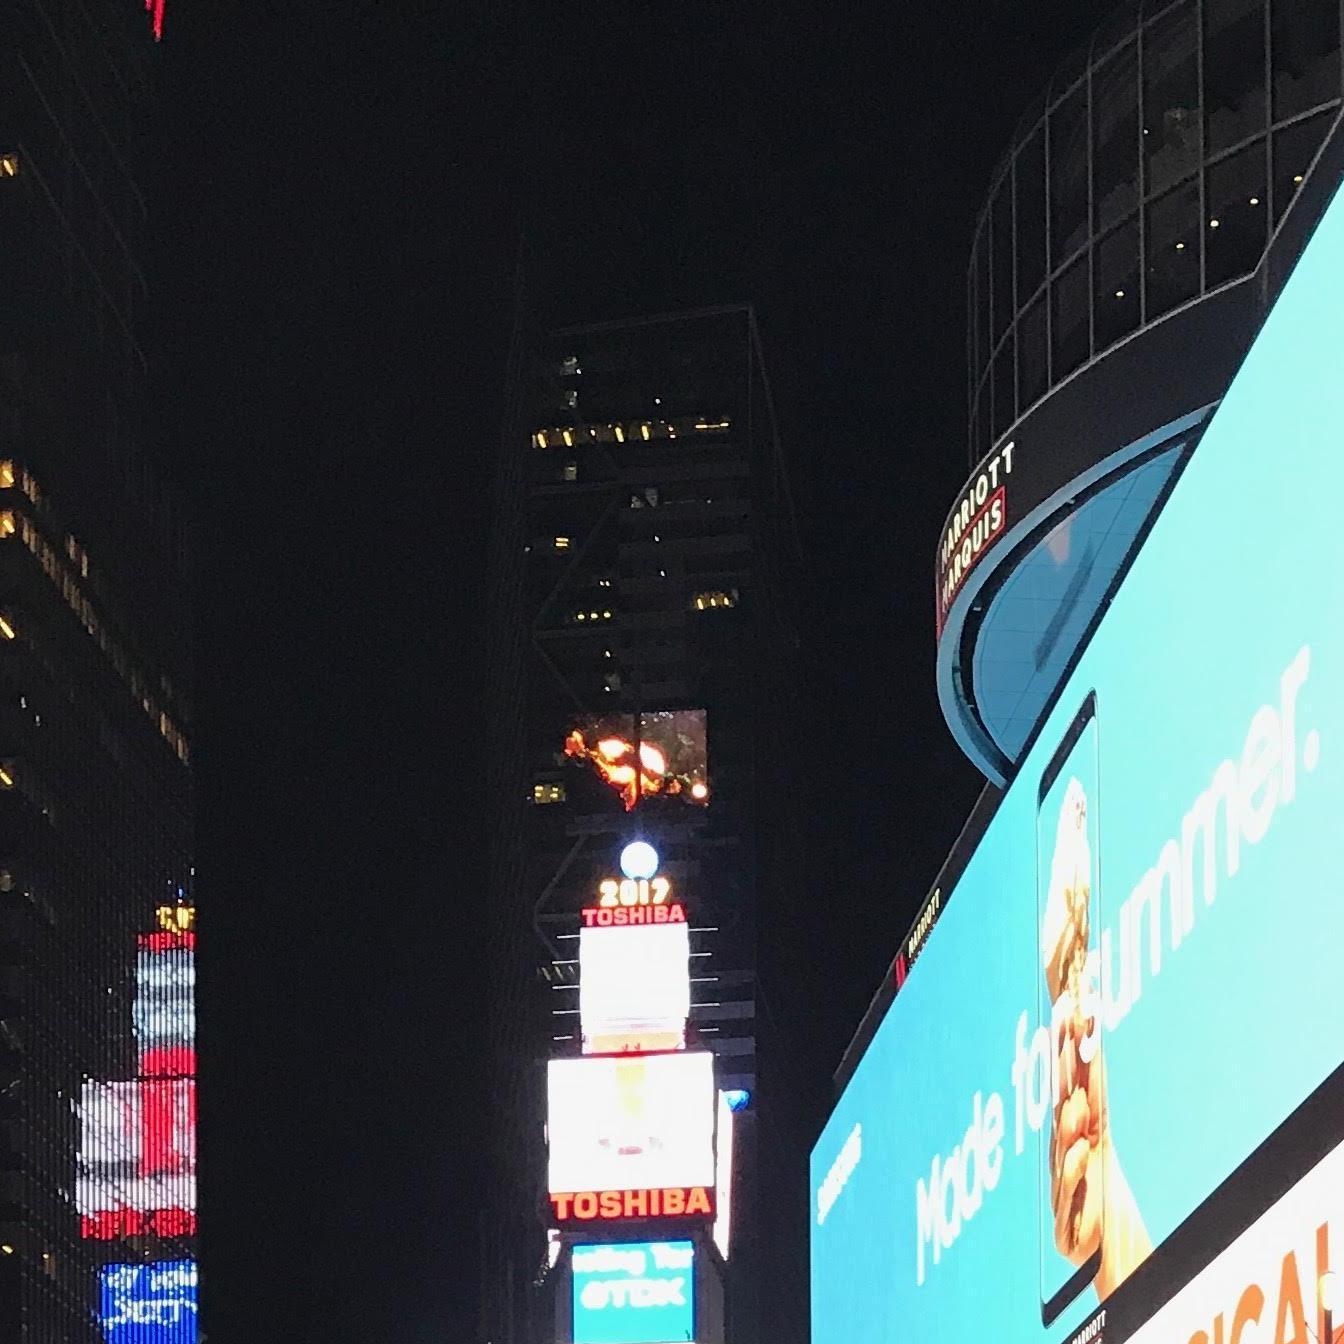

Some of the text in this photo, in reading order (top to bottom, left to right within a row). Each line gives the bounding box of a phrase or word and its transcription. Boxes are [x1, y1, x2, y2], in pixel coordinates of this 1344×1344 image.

[941, 441, 1015, 574] MARRIOTT
[942, 499, 1001, 614] MARQUIS
[581, 904, 686, 926] TOSHIBA
[599, 877, 671, 907] 2017
[551, 1187, 711, 1220] TOSHIBA
[916, 1089, 1004, 1287] Made
